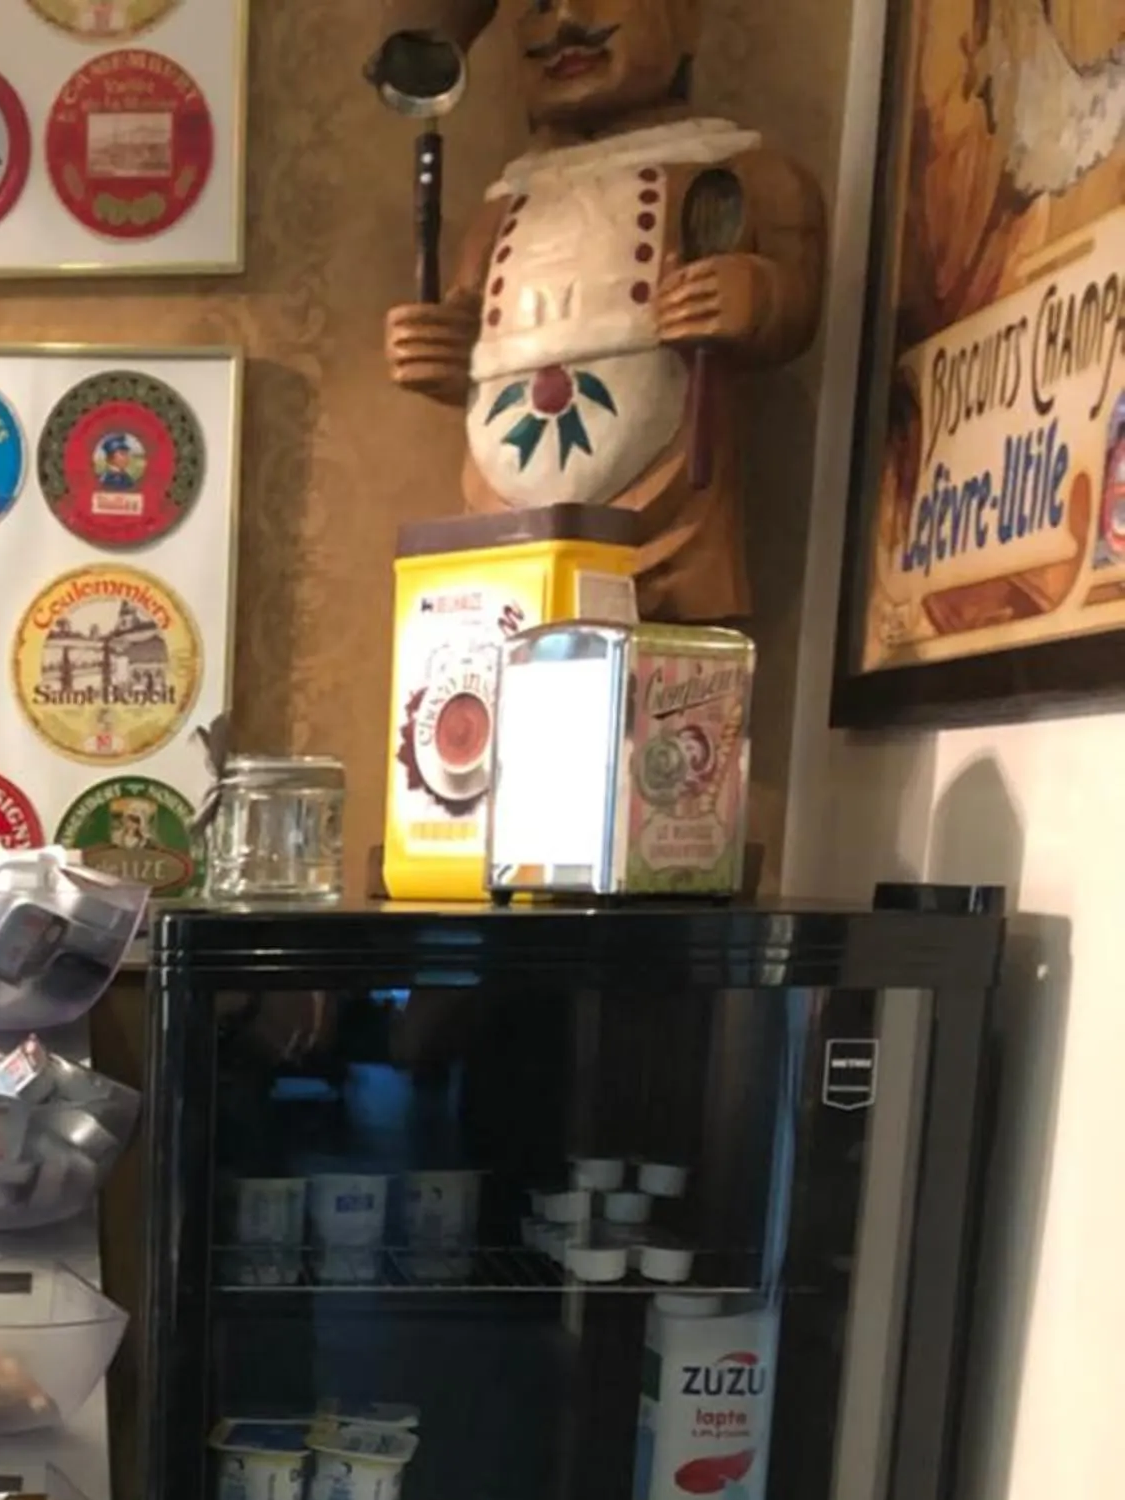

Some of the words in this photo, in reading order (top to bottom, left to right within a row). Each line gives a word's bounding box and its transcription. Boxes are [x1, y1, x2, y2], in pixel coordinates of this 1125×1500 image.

[925, 316, 1028, 465] BISCUITS
[33, 580, 173, 631] Coulommiers
[682, 1366, 767, 1396] ZUZU
[696, 1407, 747, 1429] lapte
